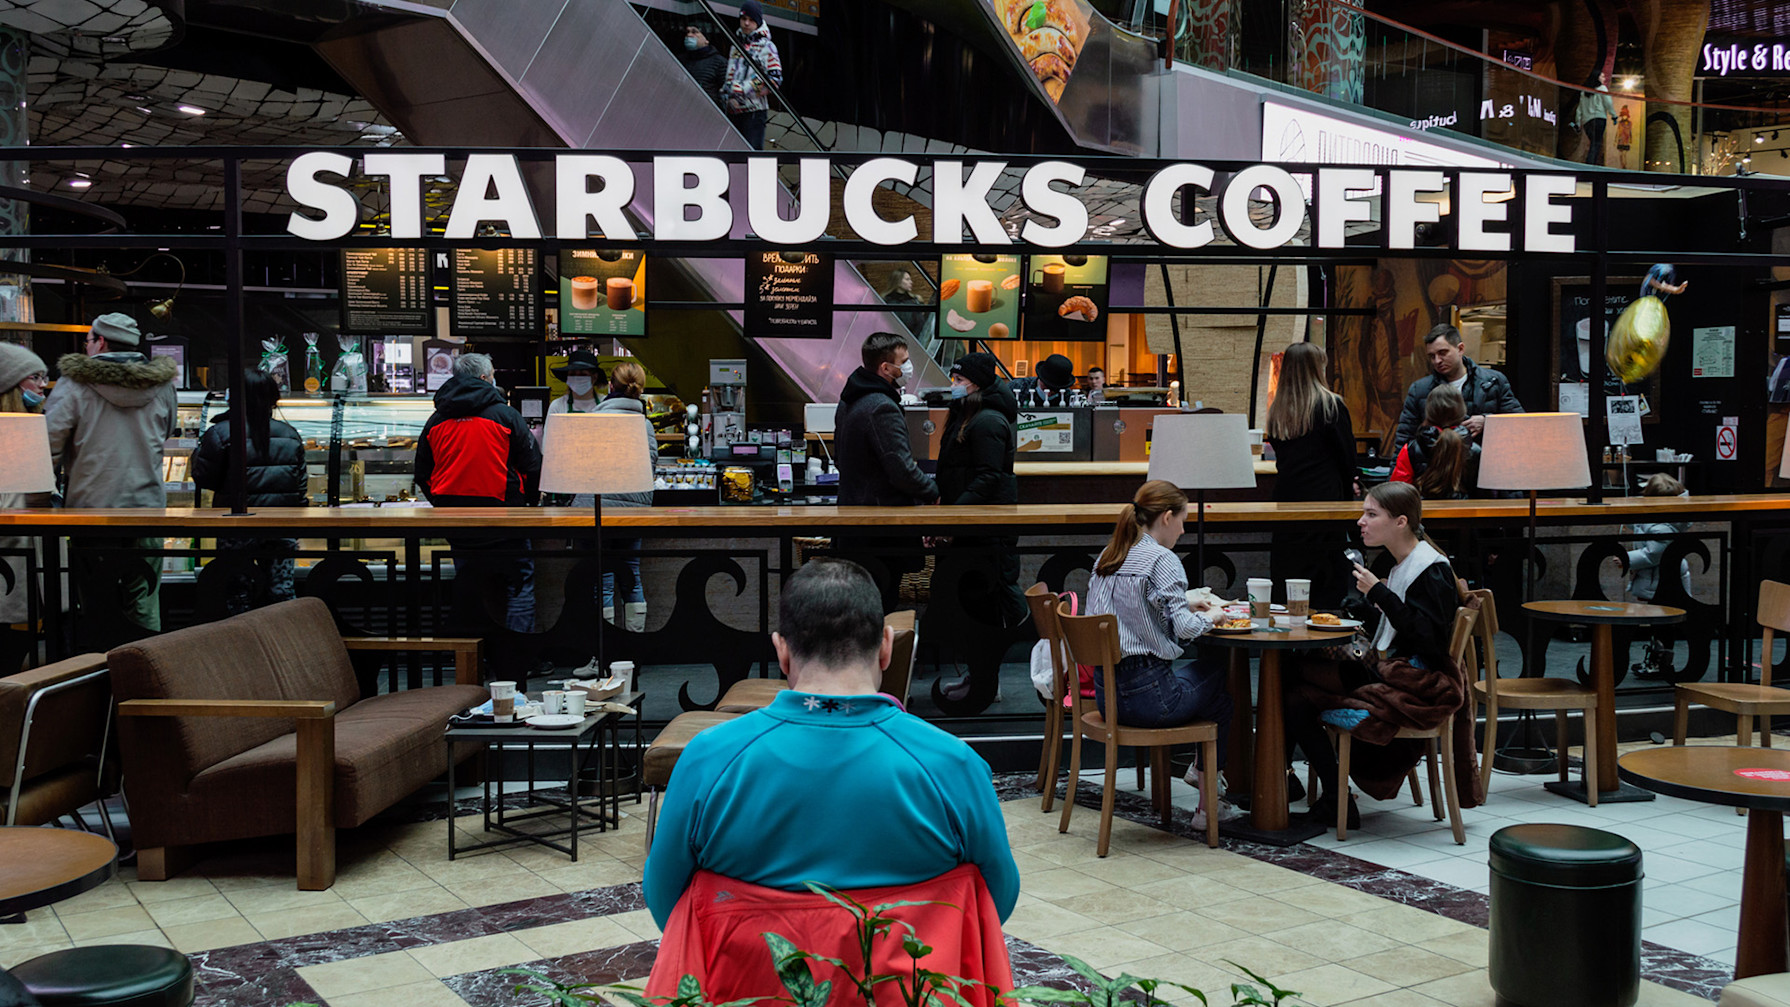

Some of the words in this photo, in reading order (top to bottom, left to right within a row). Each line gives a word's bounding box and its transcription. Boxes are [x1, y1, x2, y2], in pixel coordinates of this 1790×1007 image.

[1702, 42, 1748, 77] Style
[1751, 43, 1769, 71] &
[286, 151, 1089, 248] STARBUCKS
[1142, 163, 1576, 253] COFFEE
